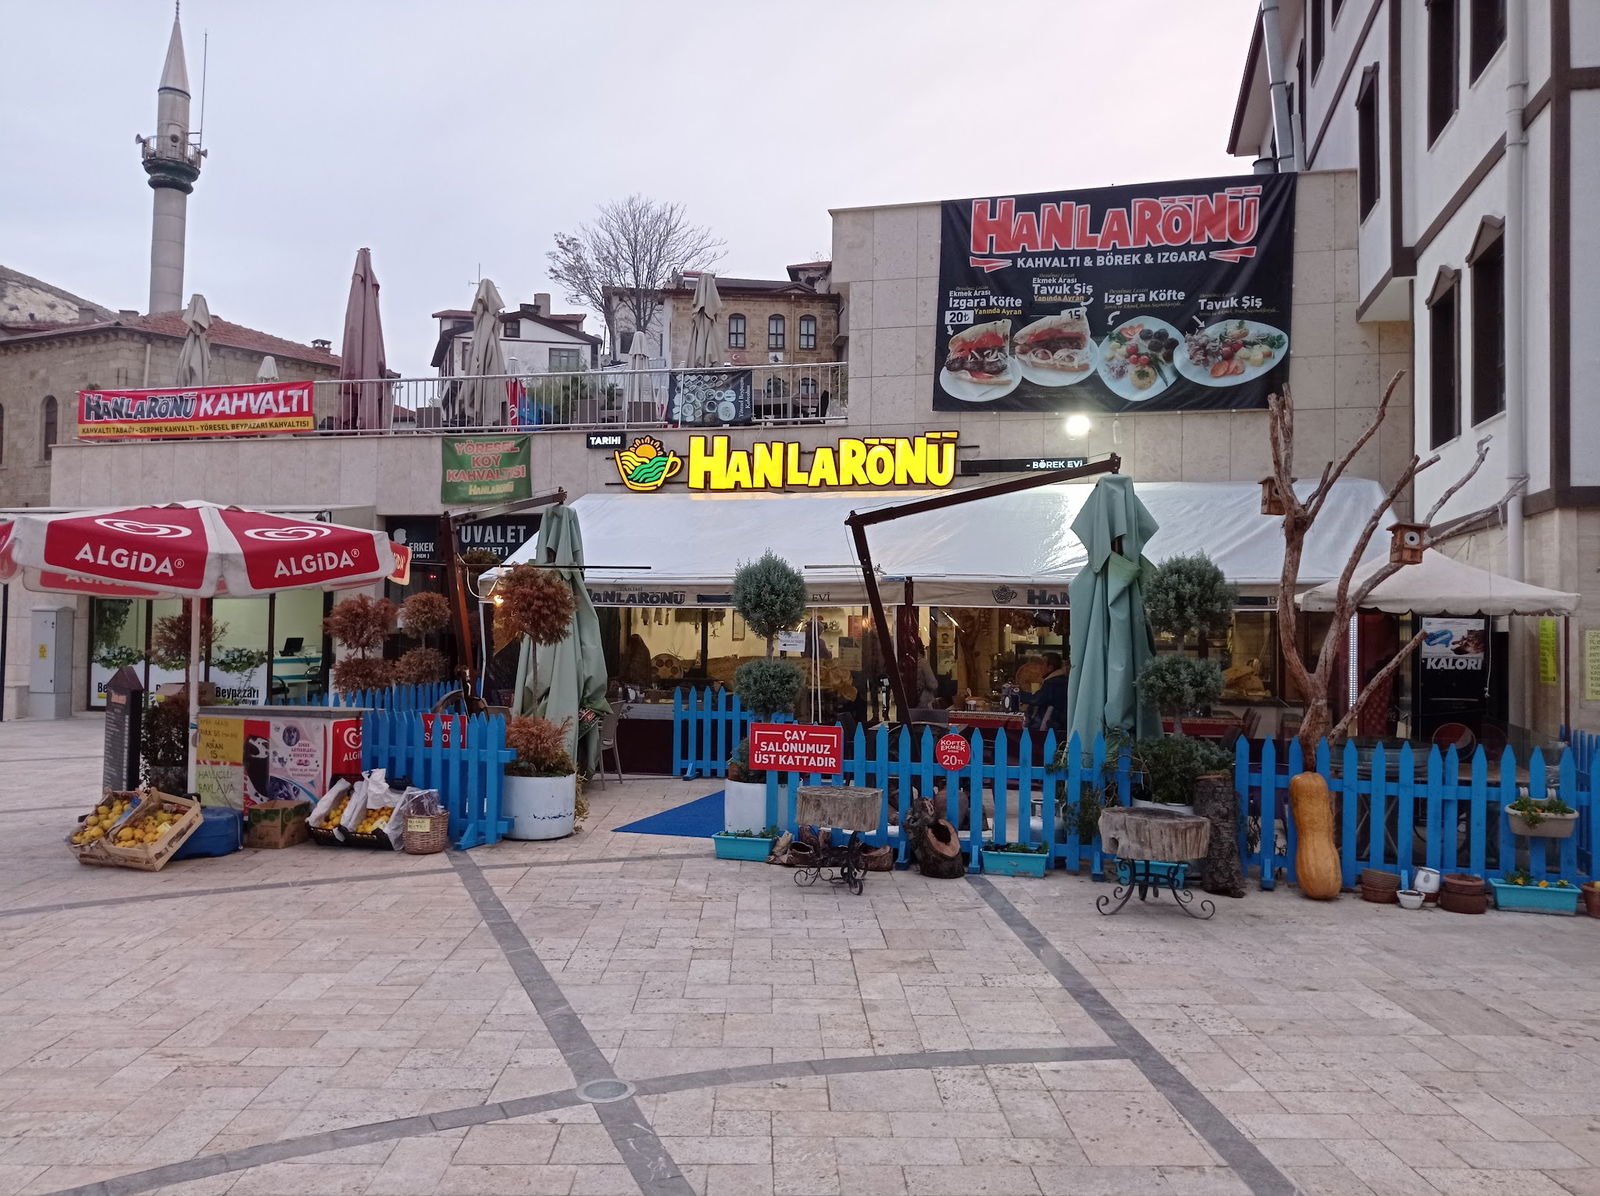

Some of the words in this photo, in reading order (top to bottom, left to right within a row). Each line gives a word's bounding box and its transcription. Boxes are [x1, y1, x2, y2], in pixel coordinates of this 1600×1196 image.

[970, 185, 1263, 254] HANLARÖNÜ
[1016, 254, 1080, 268] KAHVALTI
[1083, 254, 1093, 267] &
[1097, 251, 1140, 267] BÖREK
[1144, 253, 1154, 265] &
[1157, 250, 1207, 263] IZGARA
[1032, 283, 1071, 295] Tavuk
[1074, 283, 1094, 296] Şiş
[1104, 292, 1146, 305] Izgara
[1149, 289, 1186, 301] Köfte
[949, 297, 987, 309] Izgara
[989, 295, 1023, 307] Köfte
[1198, 297, 1239, 311] Tavuk
[1241, 295, 1263, 309] Şiş
[974, 307, 1000, 315] Yanında
[1001, 308, 1022, 316] Ayran
[84, 392, 198, 421] HANLARÖNÜ
[200, 389, 310, 417] KAHVALTI
[82, 426, 111, 434] KAHVALTI
[139, 425, 163, 433] SERPME
[164, 424, 195, 433] KAHVALTI
[200, 423, 229, 431] YÖRESEL
[231, 422, 268, 430] BEYPAZARI
[269, 420, 310, 429] KAHVALTISI
[454, 440, 520, 455] YÖRESEL
[687, 431, 959, 490] HANLARÖNÜ
[1032, 460, 1065, 469] BÖREK
[446, 465, 526, 482] KAHVALTISI
[456, 525, 527, 543] UVALET
[409, 542, 434, 552] ERKEK
[784, 729, 806, 742] ÇAY
[760, 742, 831, 754] SALONUMUZ
[754, 753, 777, 765] ÜST
[779, 755, 836, 768] KATTADIR
